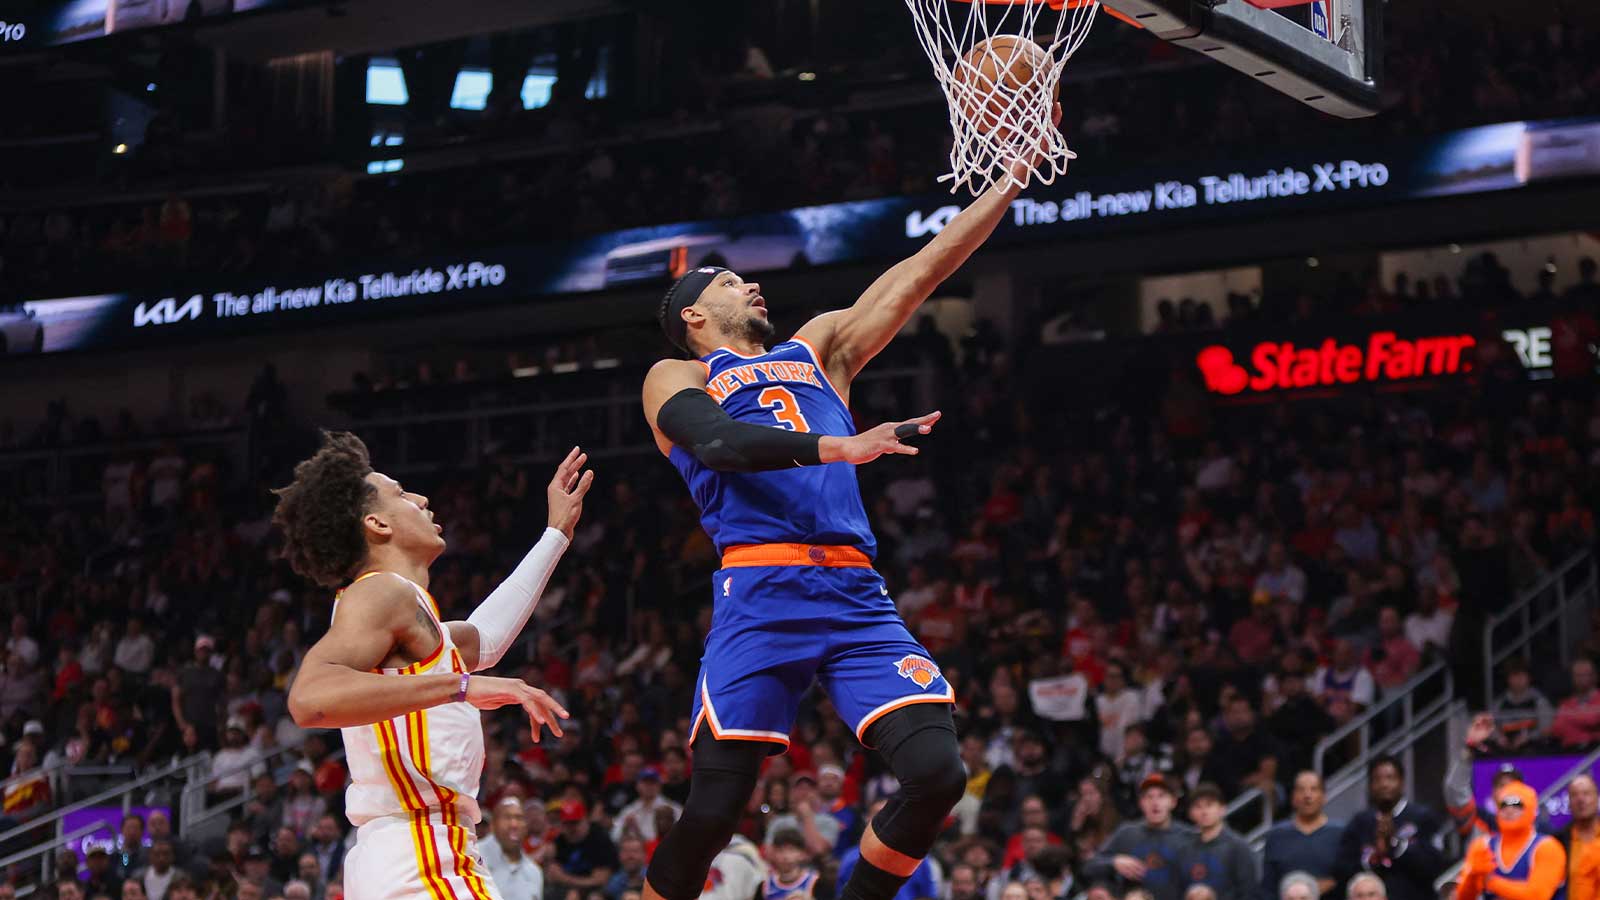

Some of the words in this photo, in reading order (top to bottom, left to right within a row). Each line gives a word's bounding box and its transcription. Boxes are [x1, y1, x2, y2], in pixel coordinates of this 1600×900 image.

[1011, 197, 1059, 226] The
[1061, 191, 1152, 222] all-new
[1154, 180, 1197, 210] Kia
[1199, 167, 1310, 205] Telluride
[1312, 160, 1389, 192] X-Pro
[212, 291, 249, 318] The
[252, 286, 322, 314] all-new
[324, 278, 357, 304] Kia
[359, 267, 445, 300] Telluride
[446, 261, 506, 291] X-Pro
[705, 365, 759, 405] NEW
[752, 361, 823, 389] YORK
[1250, 337, 1363, 391] State
[758, 386, 810, 433] 3
